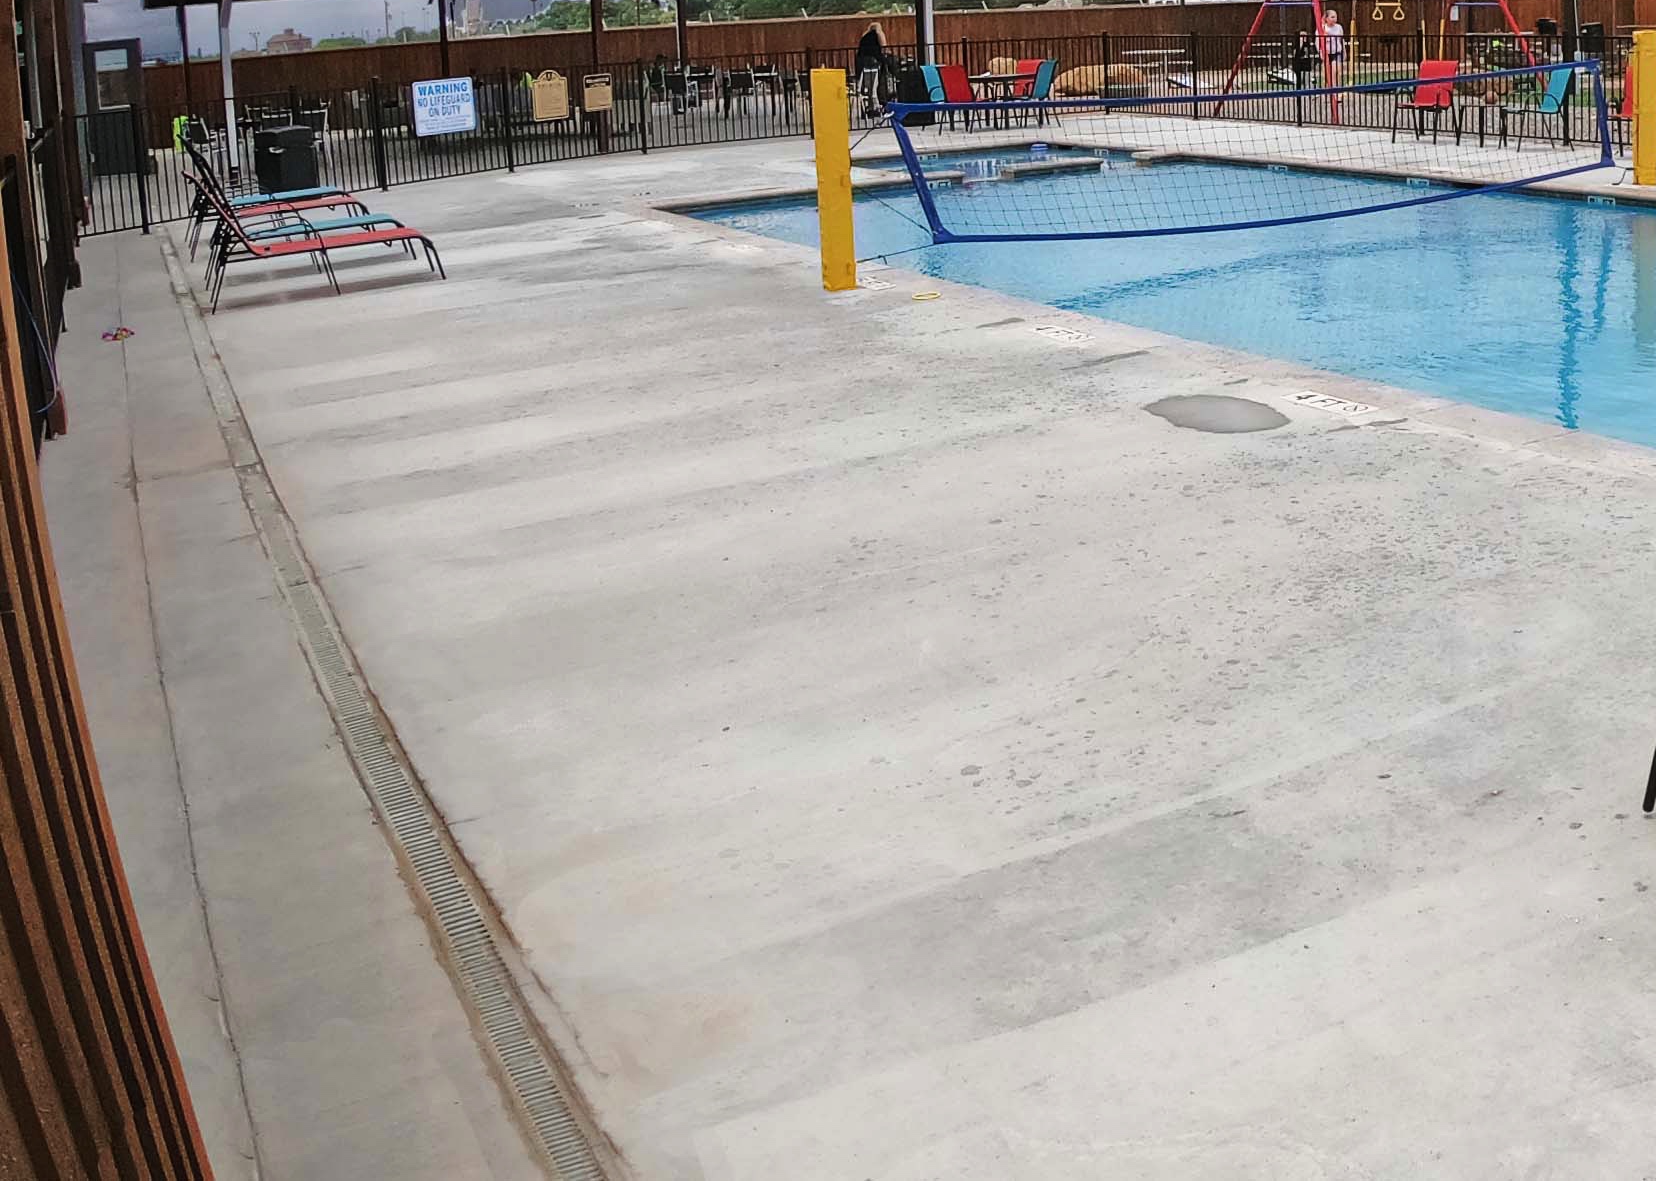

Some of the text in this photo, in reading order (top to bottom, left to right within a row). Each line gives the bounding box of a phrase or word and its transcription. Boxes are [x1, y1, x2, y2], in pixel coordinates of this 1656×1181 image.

[418, 82, 468, 96] WARNING
[418, 93, 470, 107] NO LIFEGUARD
[429, 105, 461, 117] ON DUTY
